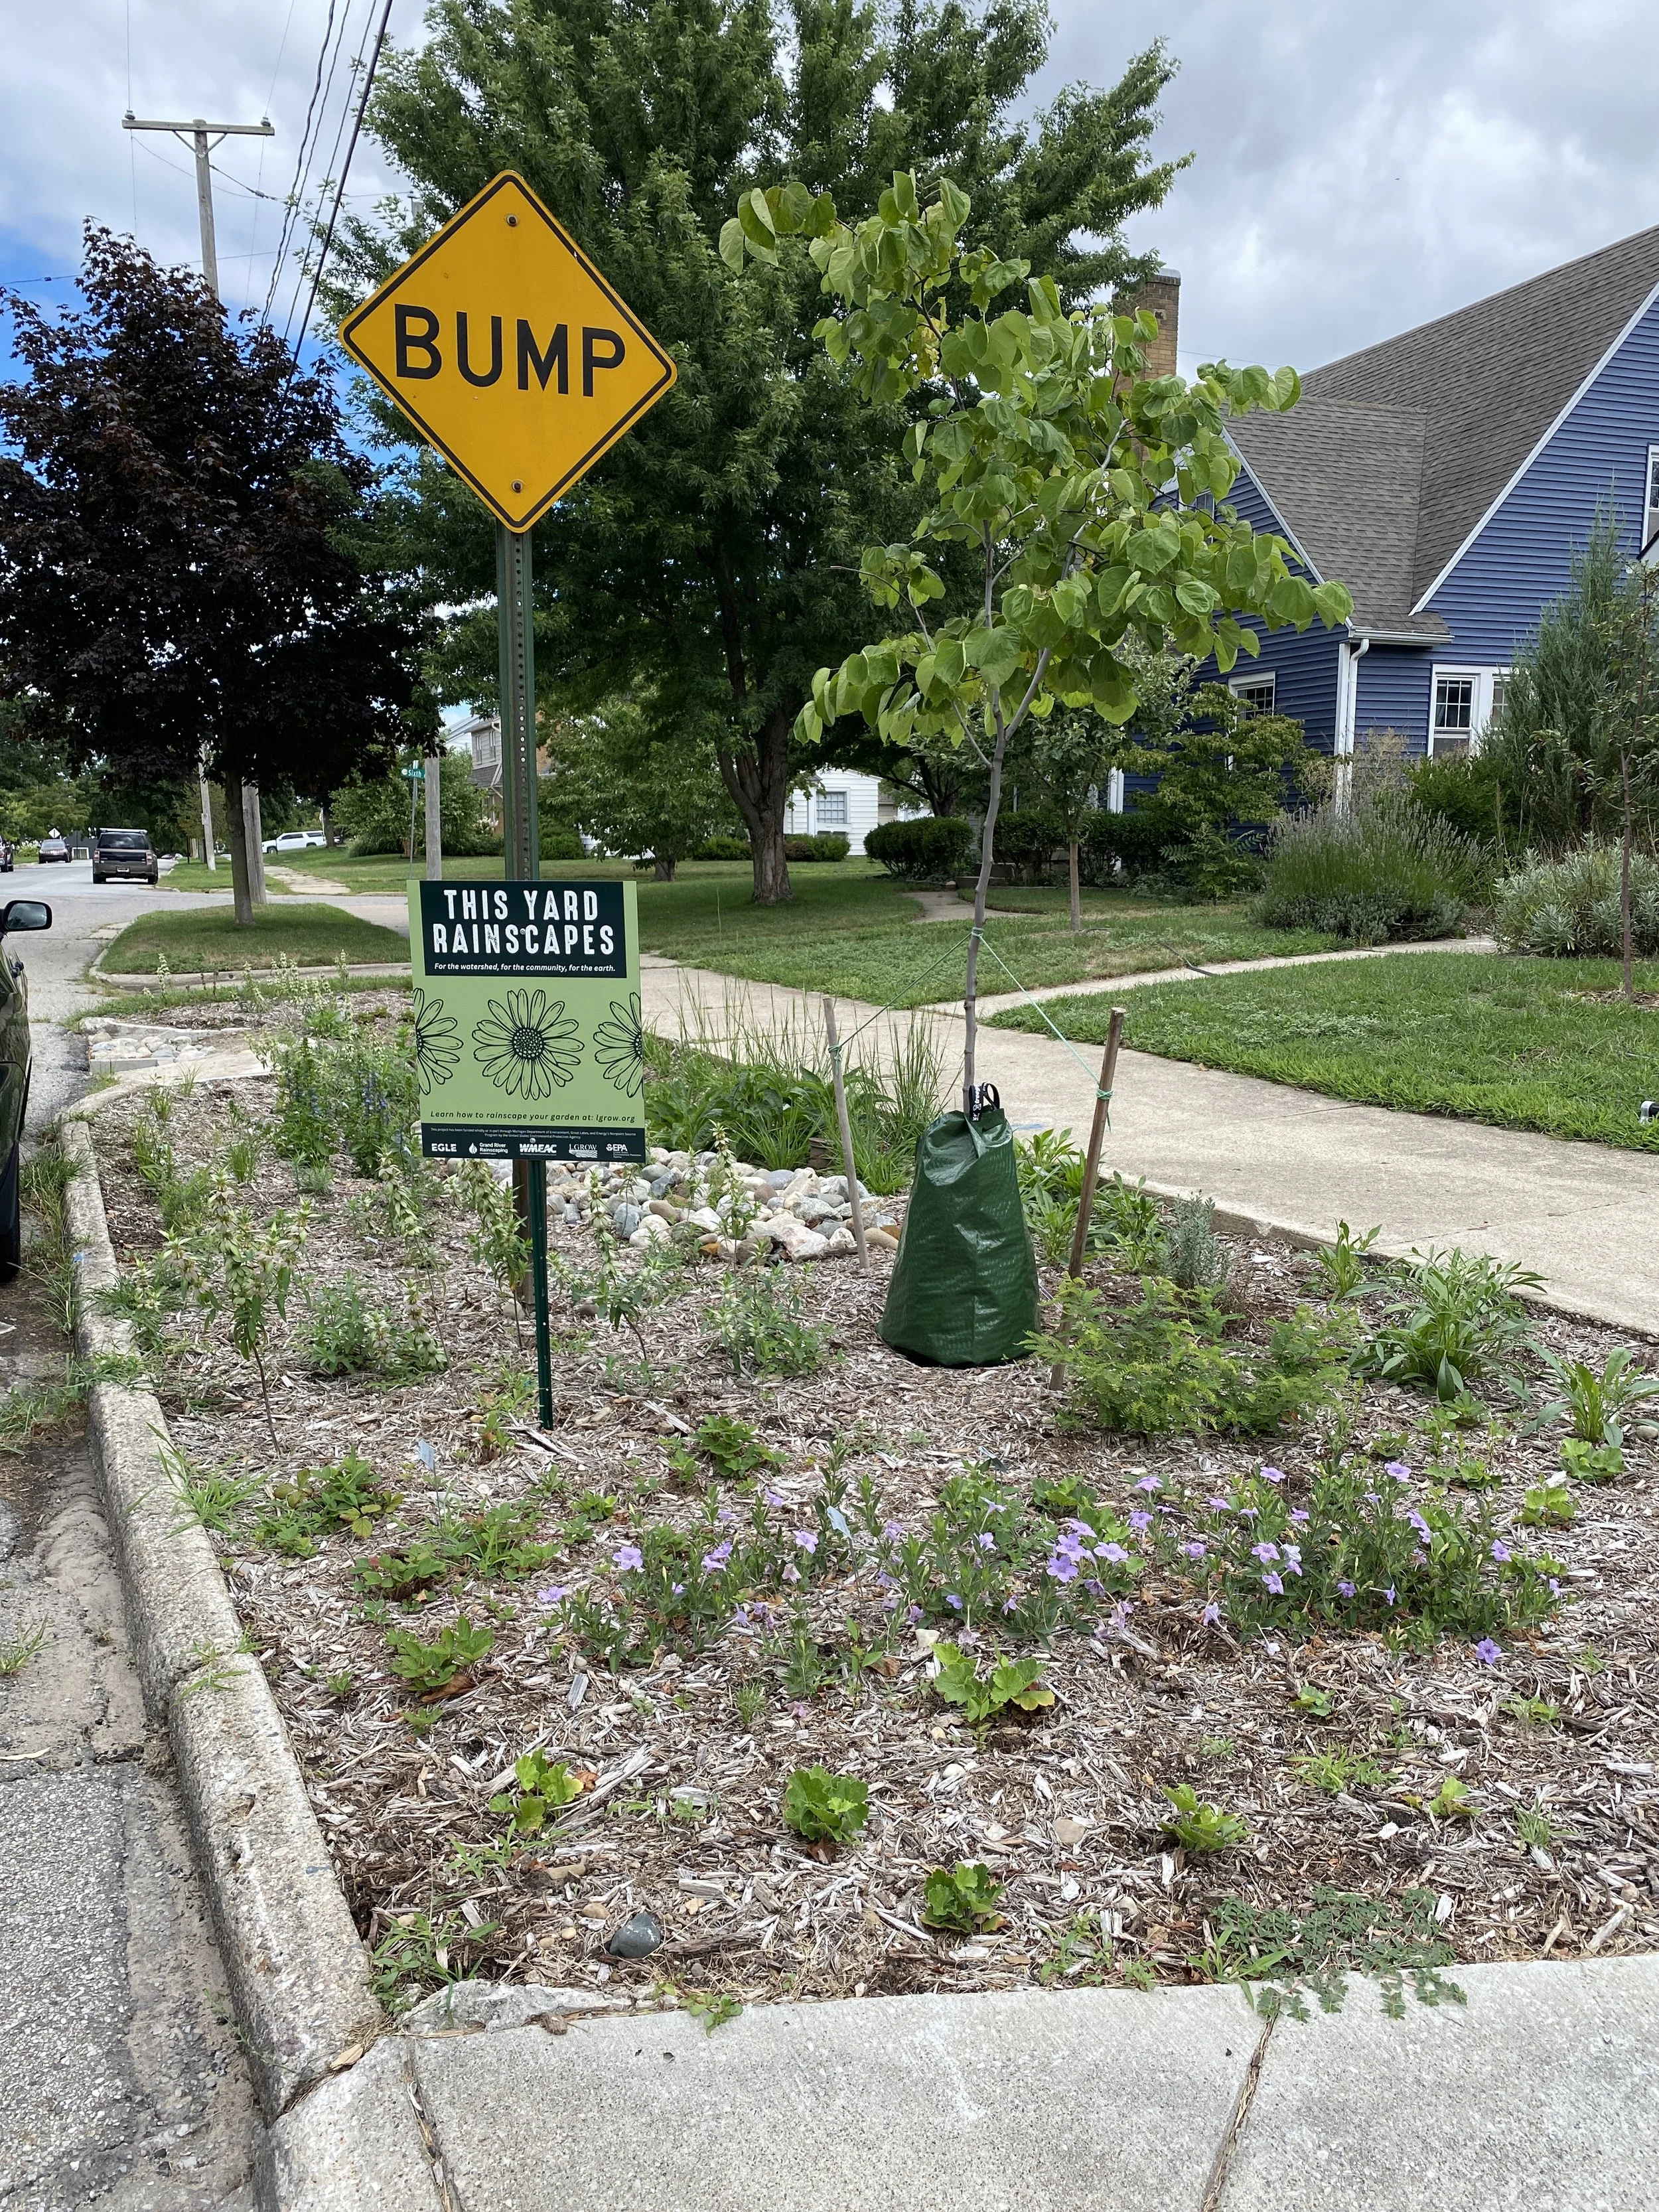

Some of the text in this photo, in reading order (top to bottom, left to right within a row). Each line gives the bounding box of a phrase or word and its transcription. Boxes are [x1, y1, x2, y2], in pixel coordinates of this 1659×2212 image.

[394, 303, 626, 398] BUMP
[408, 769, 422, 778] Sixth
[443, 889, 598, 921] THIS YARD
[433, 923, 614, 955] RAINSCAPES
[461, 963, 500, 972] watershed,
[526, 964, 568, 973] community,
[486, 1112, 528, 1121] rainscape
[595, 1114, 636, 1124] lgrow.org
[431, 1143, 457, 1152] EGLE
[519, 1143, 557, 1153] WMEAC
